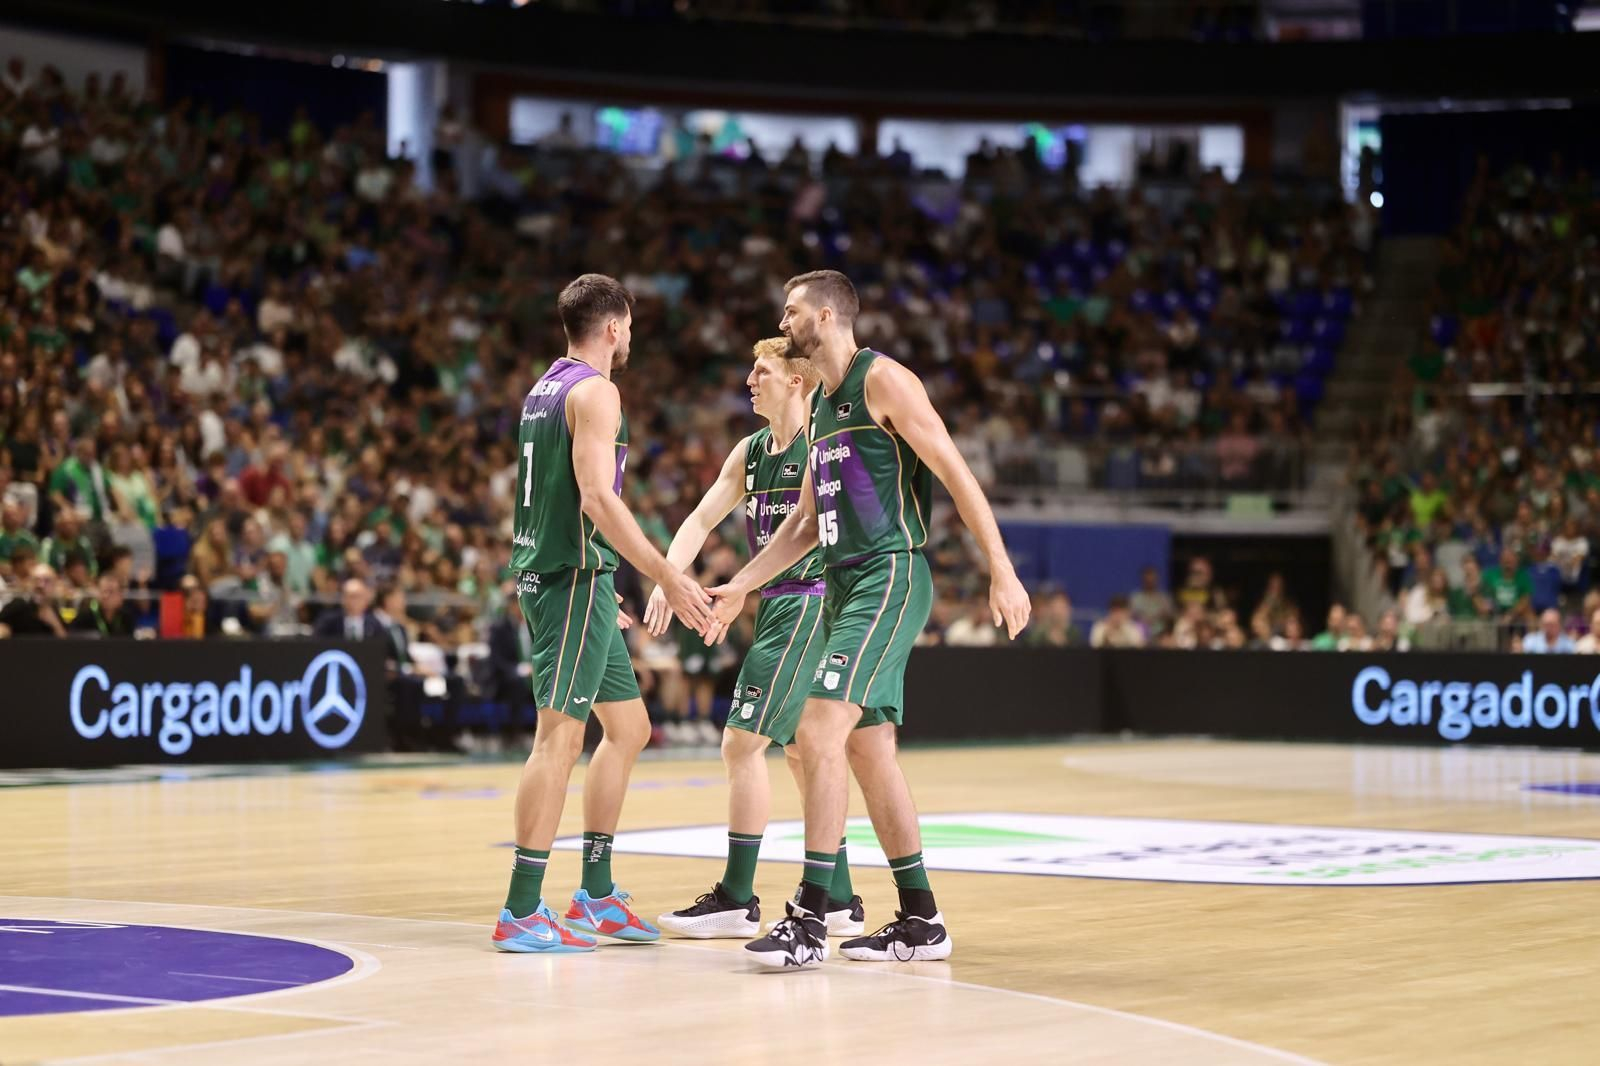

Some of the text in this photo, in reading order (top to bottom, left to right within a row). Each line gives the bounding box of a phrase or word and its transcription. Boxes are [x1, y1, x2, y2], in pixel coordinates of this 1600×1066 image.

[818, 443, 852, 466] Unicaja
[69, 663, 303, 756] Cargador
[1351, 665, 1590, 742] Cargador
